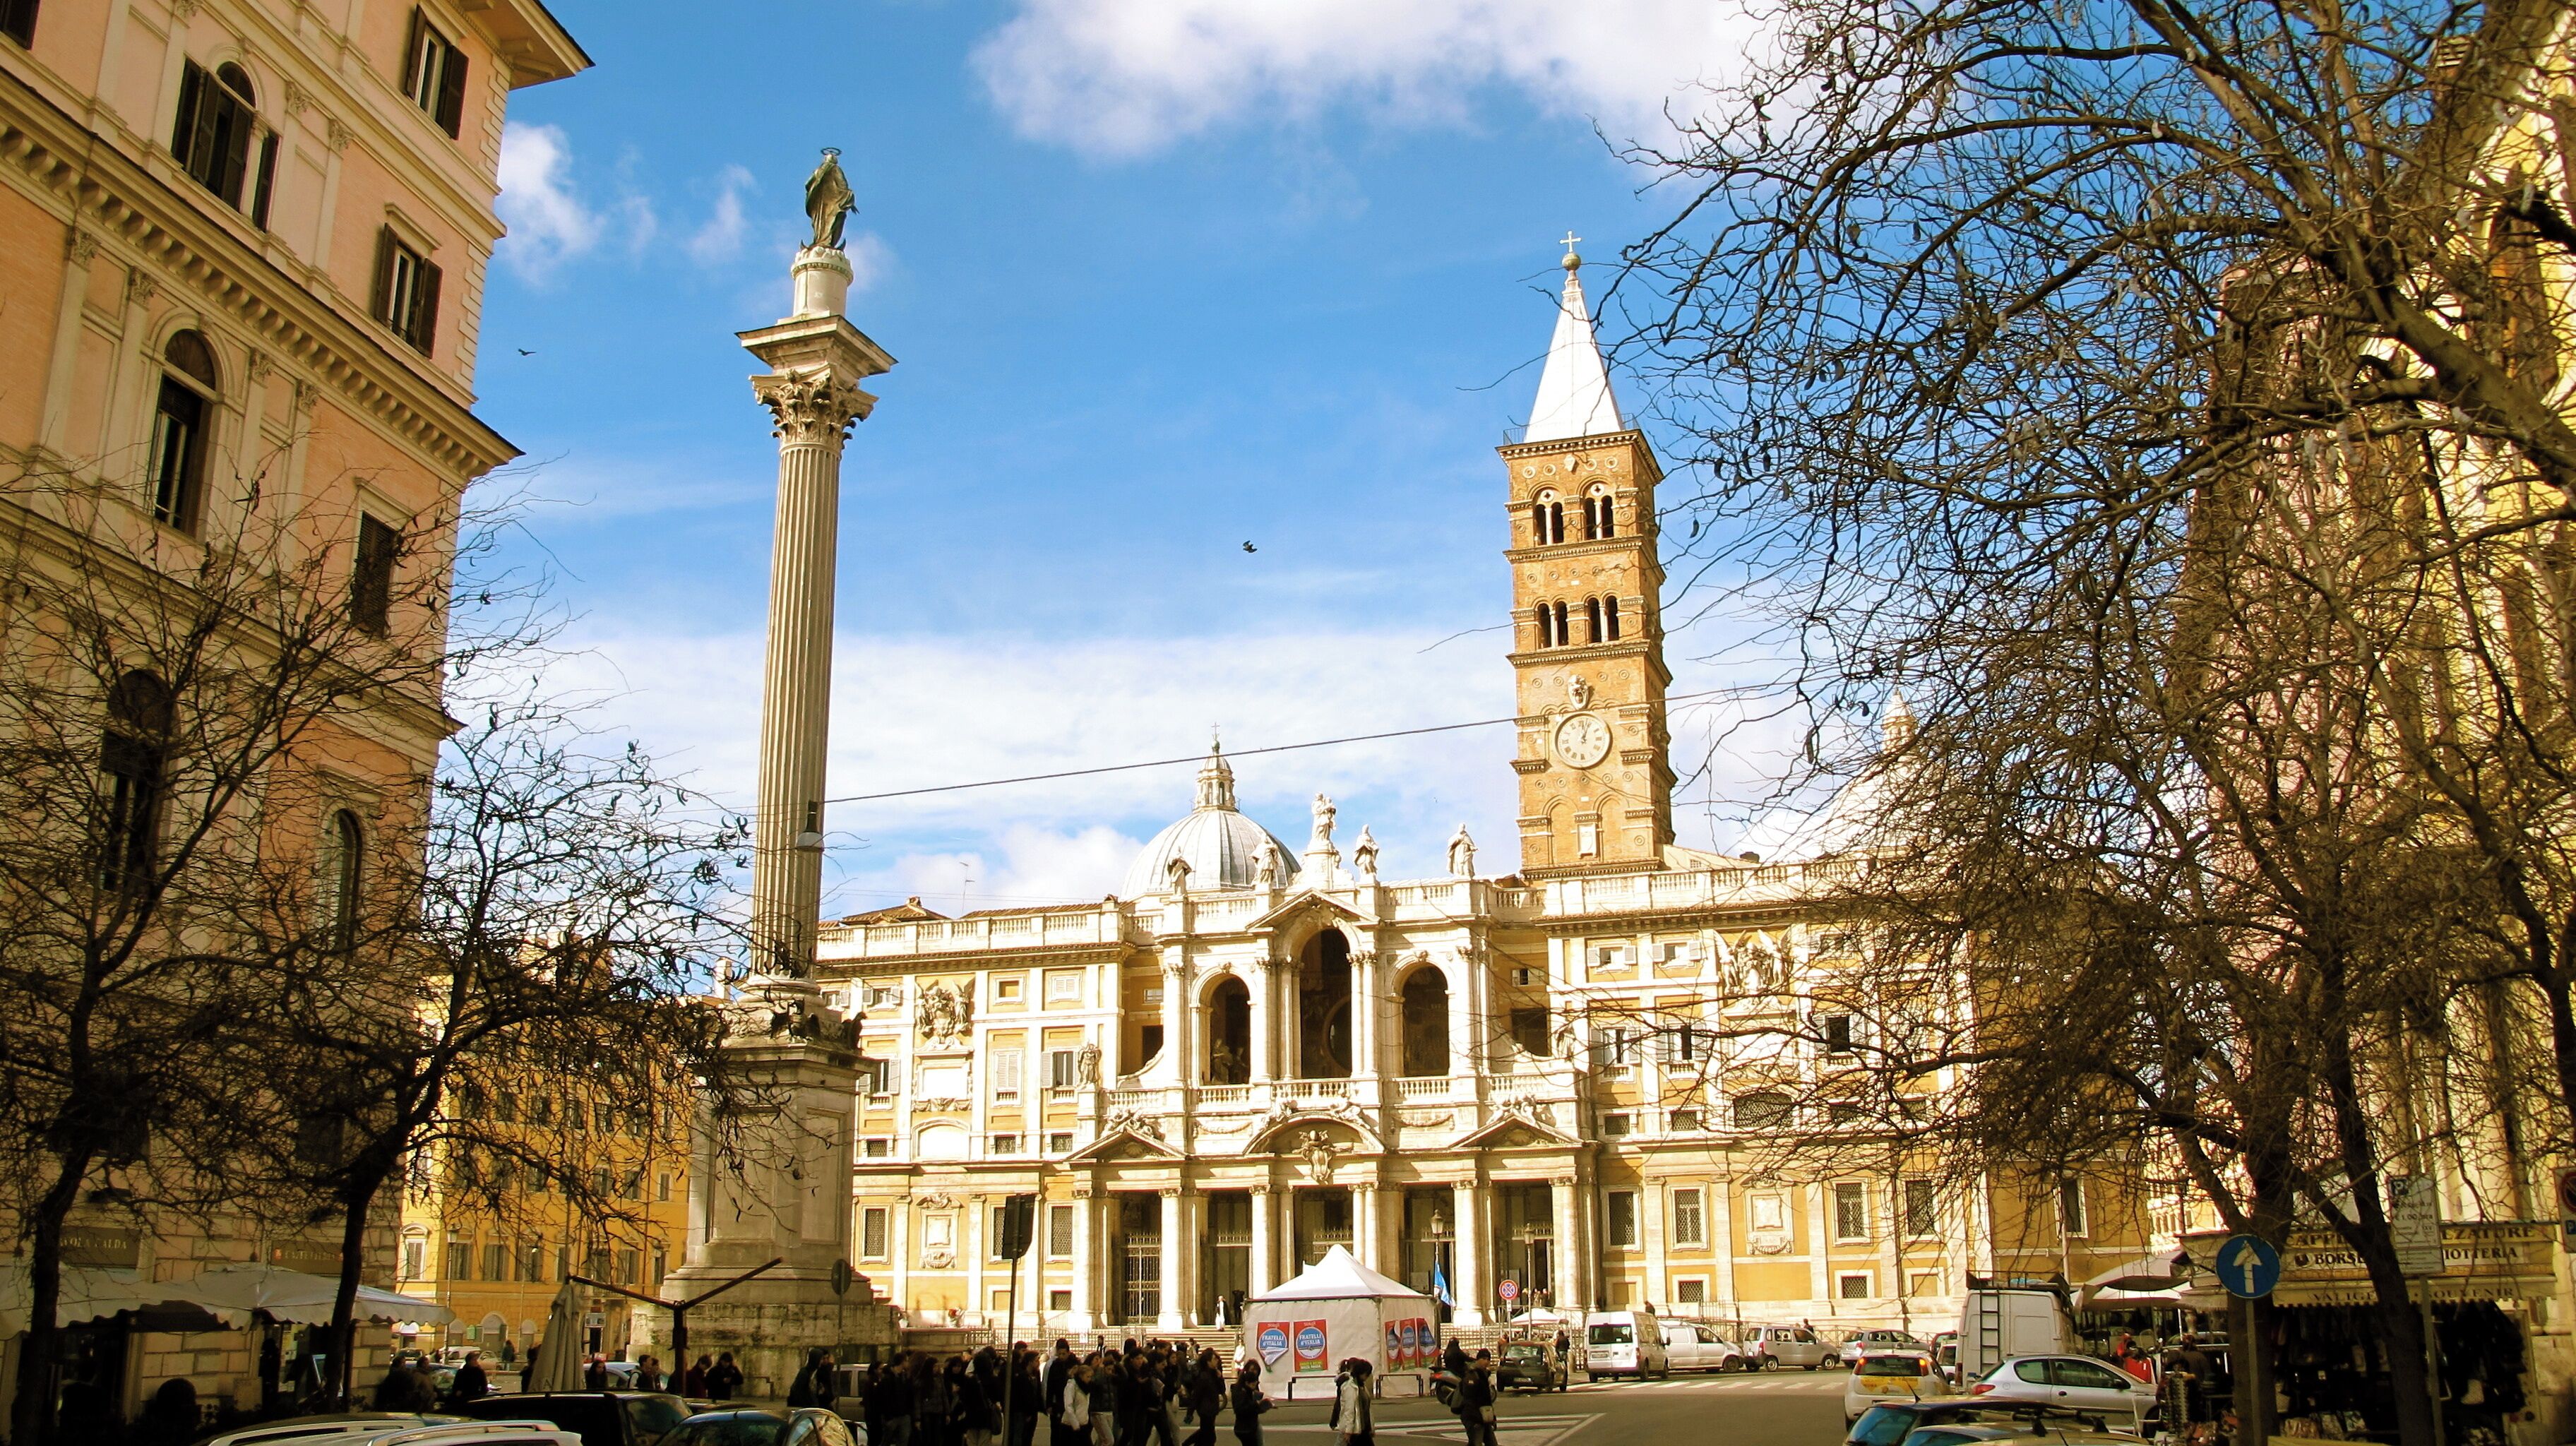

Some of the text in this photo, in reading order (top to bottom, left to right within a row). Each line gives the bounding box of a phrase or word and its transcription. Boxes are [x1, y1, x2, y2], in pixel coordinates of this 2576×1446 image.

[2441, 1226, 2535, 1240] LZATURE
[2445, 1246, 2518, 1260] IOTTERIA
[2313, 1287, 2514, 1301] VALIGE SOUVENIR
